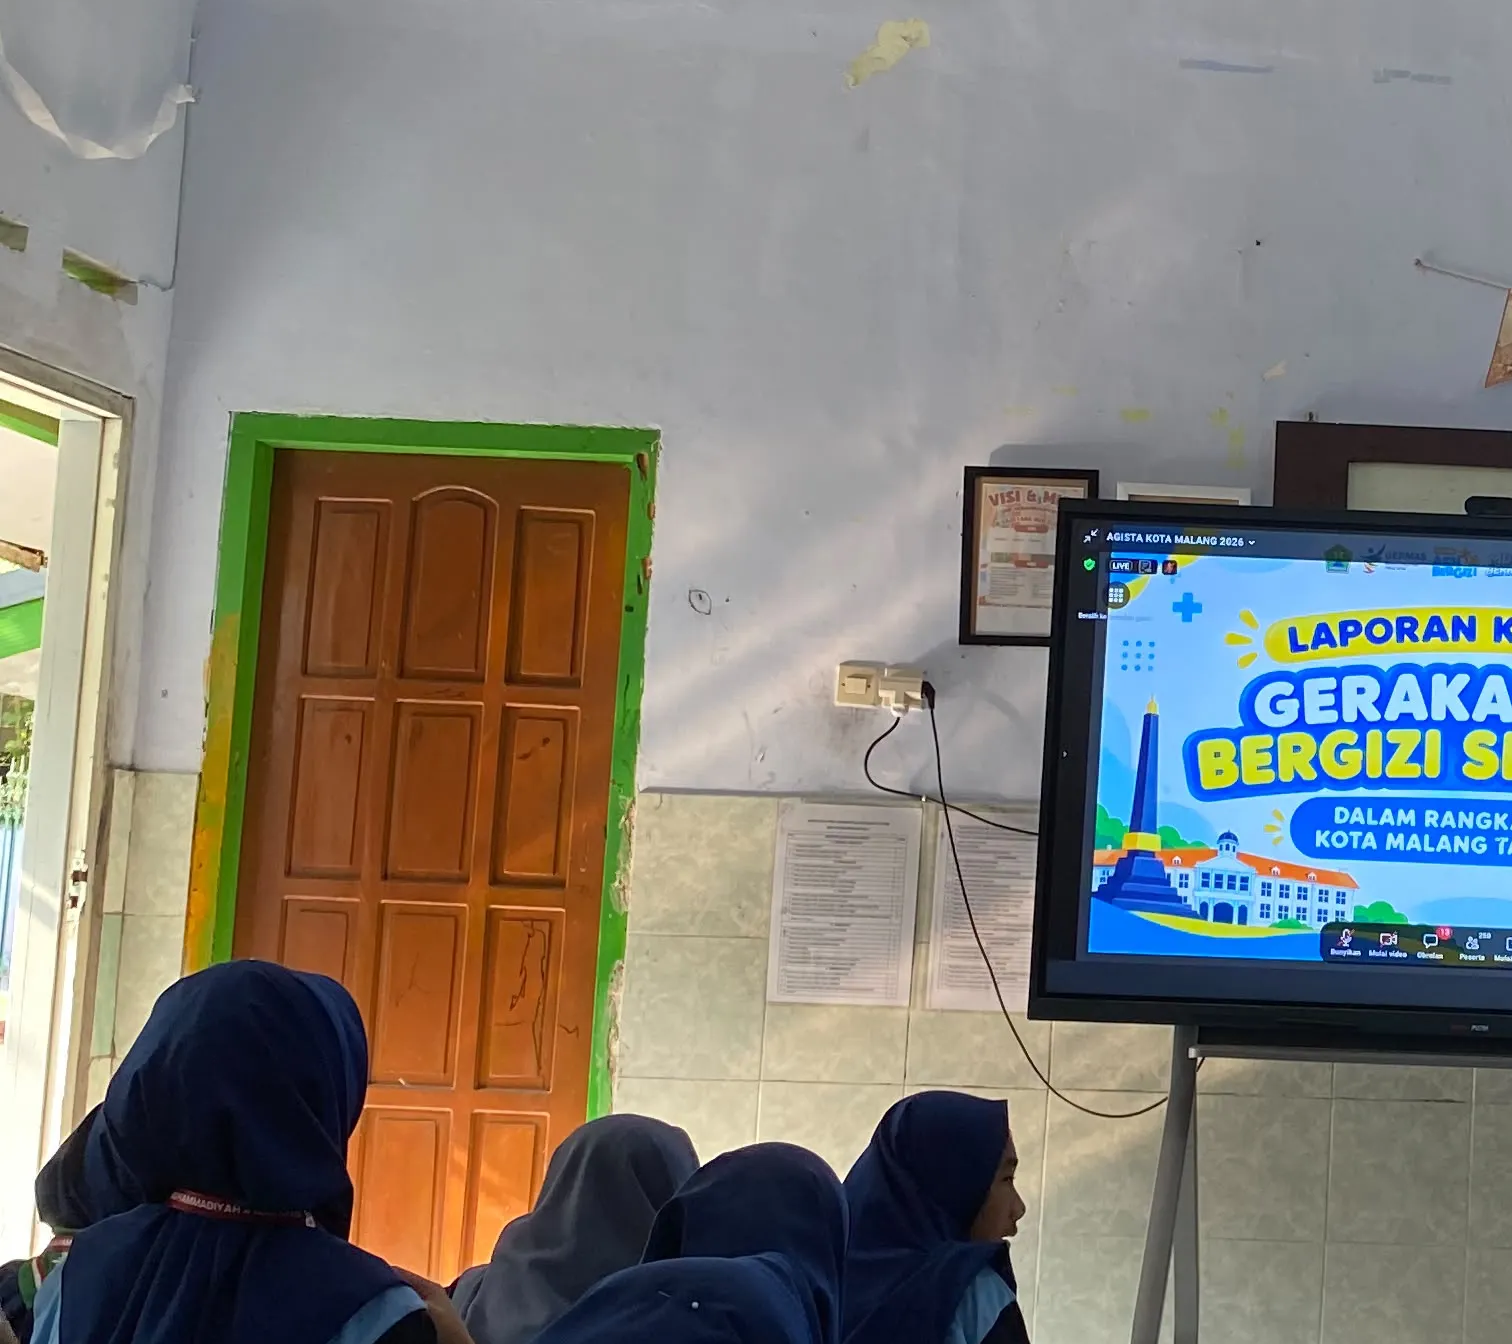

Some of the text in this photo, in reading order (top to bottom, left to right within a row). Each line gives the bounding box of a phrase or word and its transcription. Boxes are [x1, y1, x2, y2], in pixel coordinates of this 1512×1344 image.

[988, 491, 1020, 506] VISI
[1106, 532, 1244, 547] AGISTA KOTA MALANG 2026
[1112, 562, 1130, 570] LIVE
[1288, 616, 1477, 654] LAPORAN
[1197, 729, 1441, 791] BERGIZI
[1334, 806, 1417, 828] DALAM
[1315, 831, 1377, 851] KOTA
[1384, 834, 1489, 856] MALANG
[1389, 950, 1408, 959] video
[1459, 953, 1486, 962] Peserta
